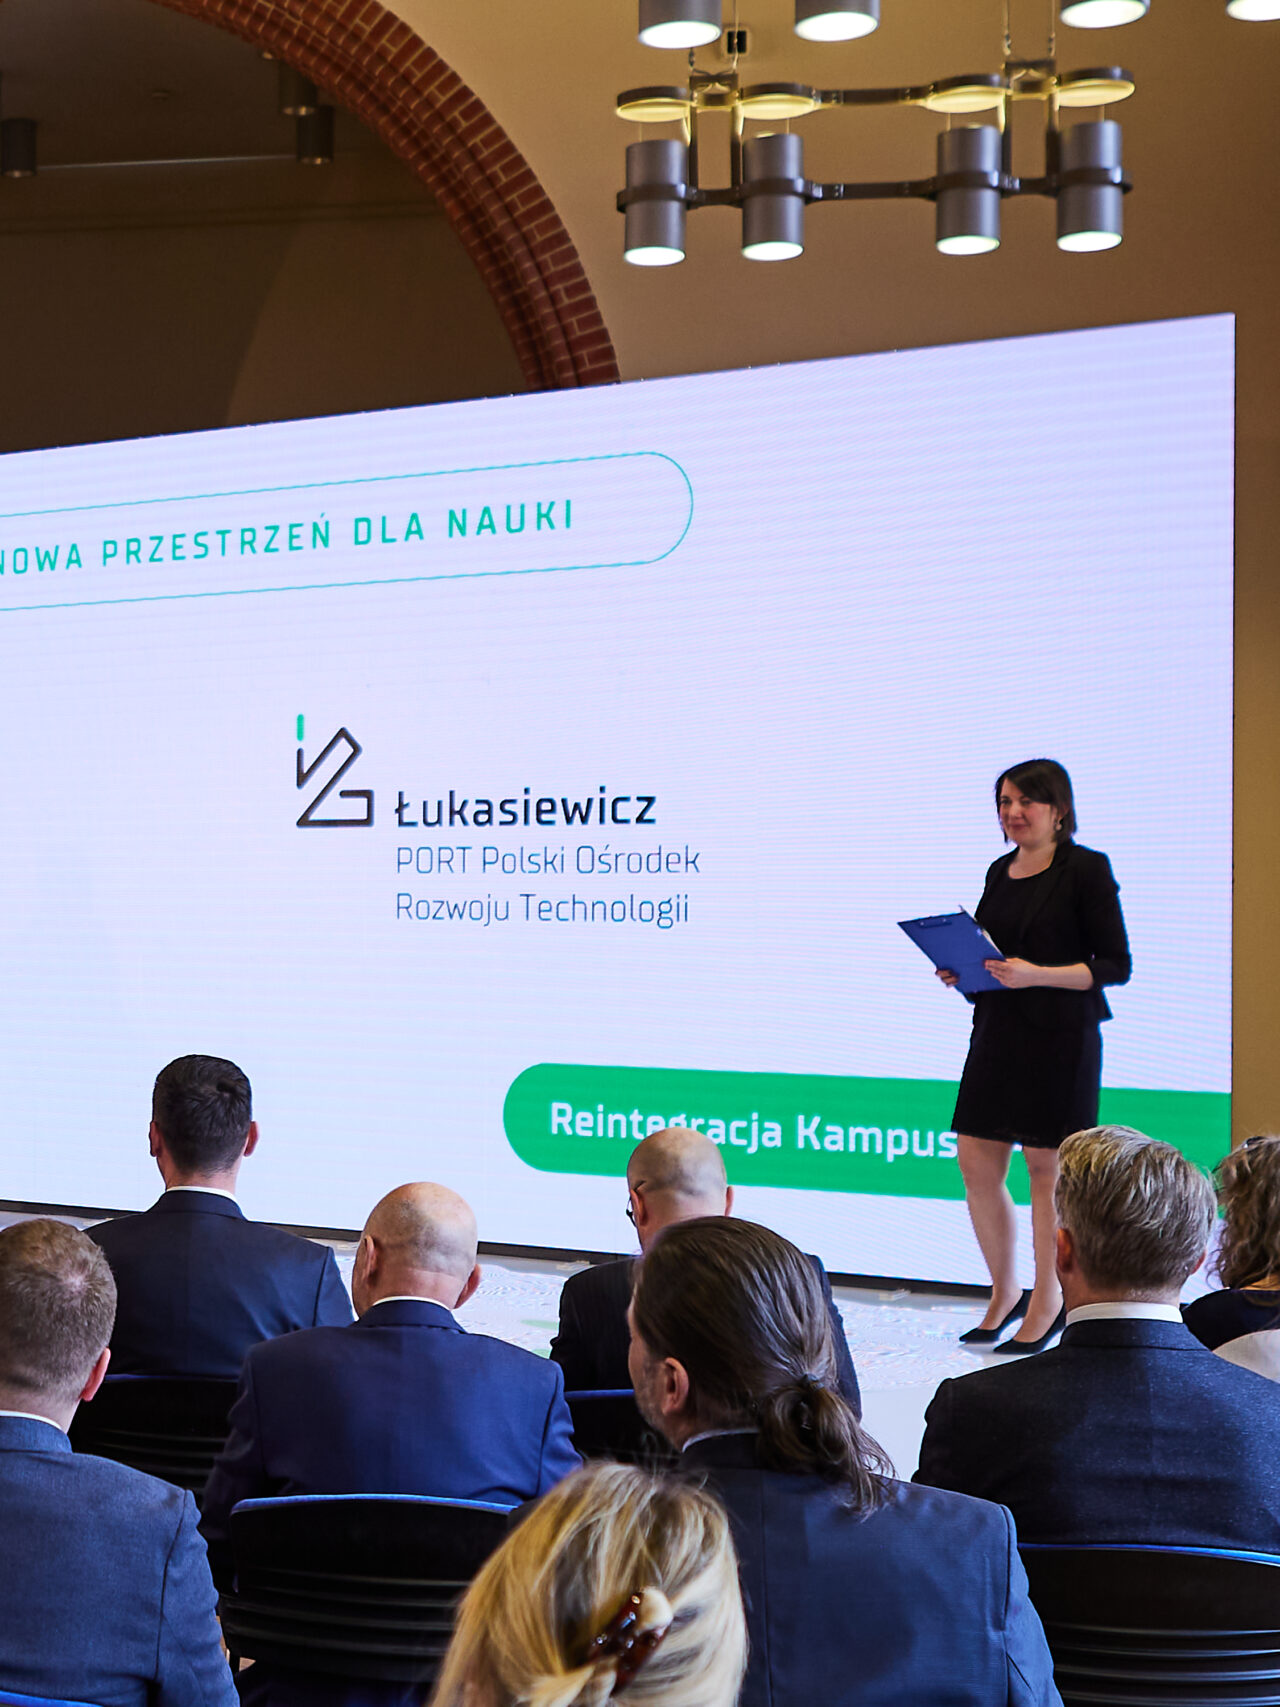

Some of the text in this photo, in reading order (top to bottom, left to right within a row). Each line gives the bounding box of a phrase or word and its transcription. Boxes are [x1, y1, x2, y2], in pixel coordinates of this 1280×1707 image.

[102, 512, 330, 566] PRZESTRZEŃ
[353, 512, 425, 546] DLA
[448, 499, 572, 538] NAUKI
[395, 785, 657, 828] Łukasiewicz
[396, 844, 701, 875] PORT Polski Ośrodek
[396, 893, 689, 929] Rozwoju Technologii
